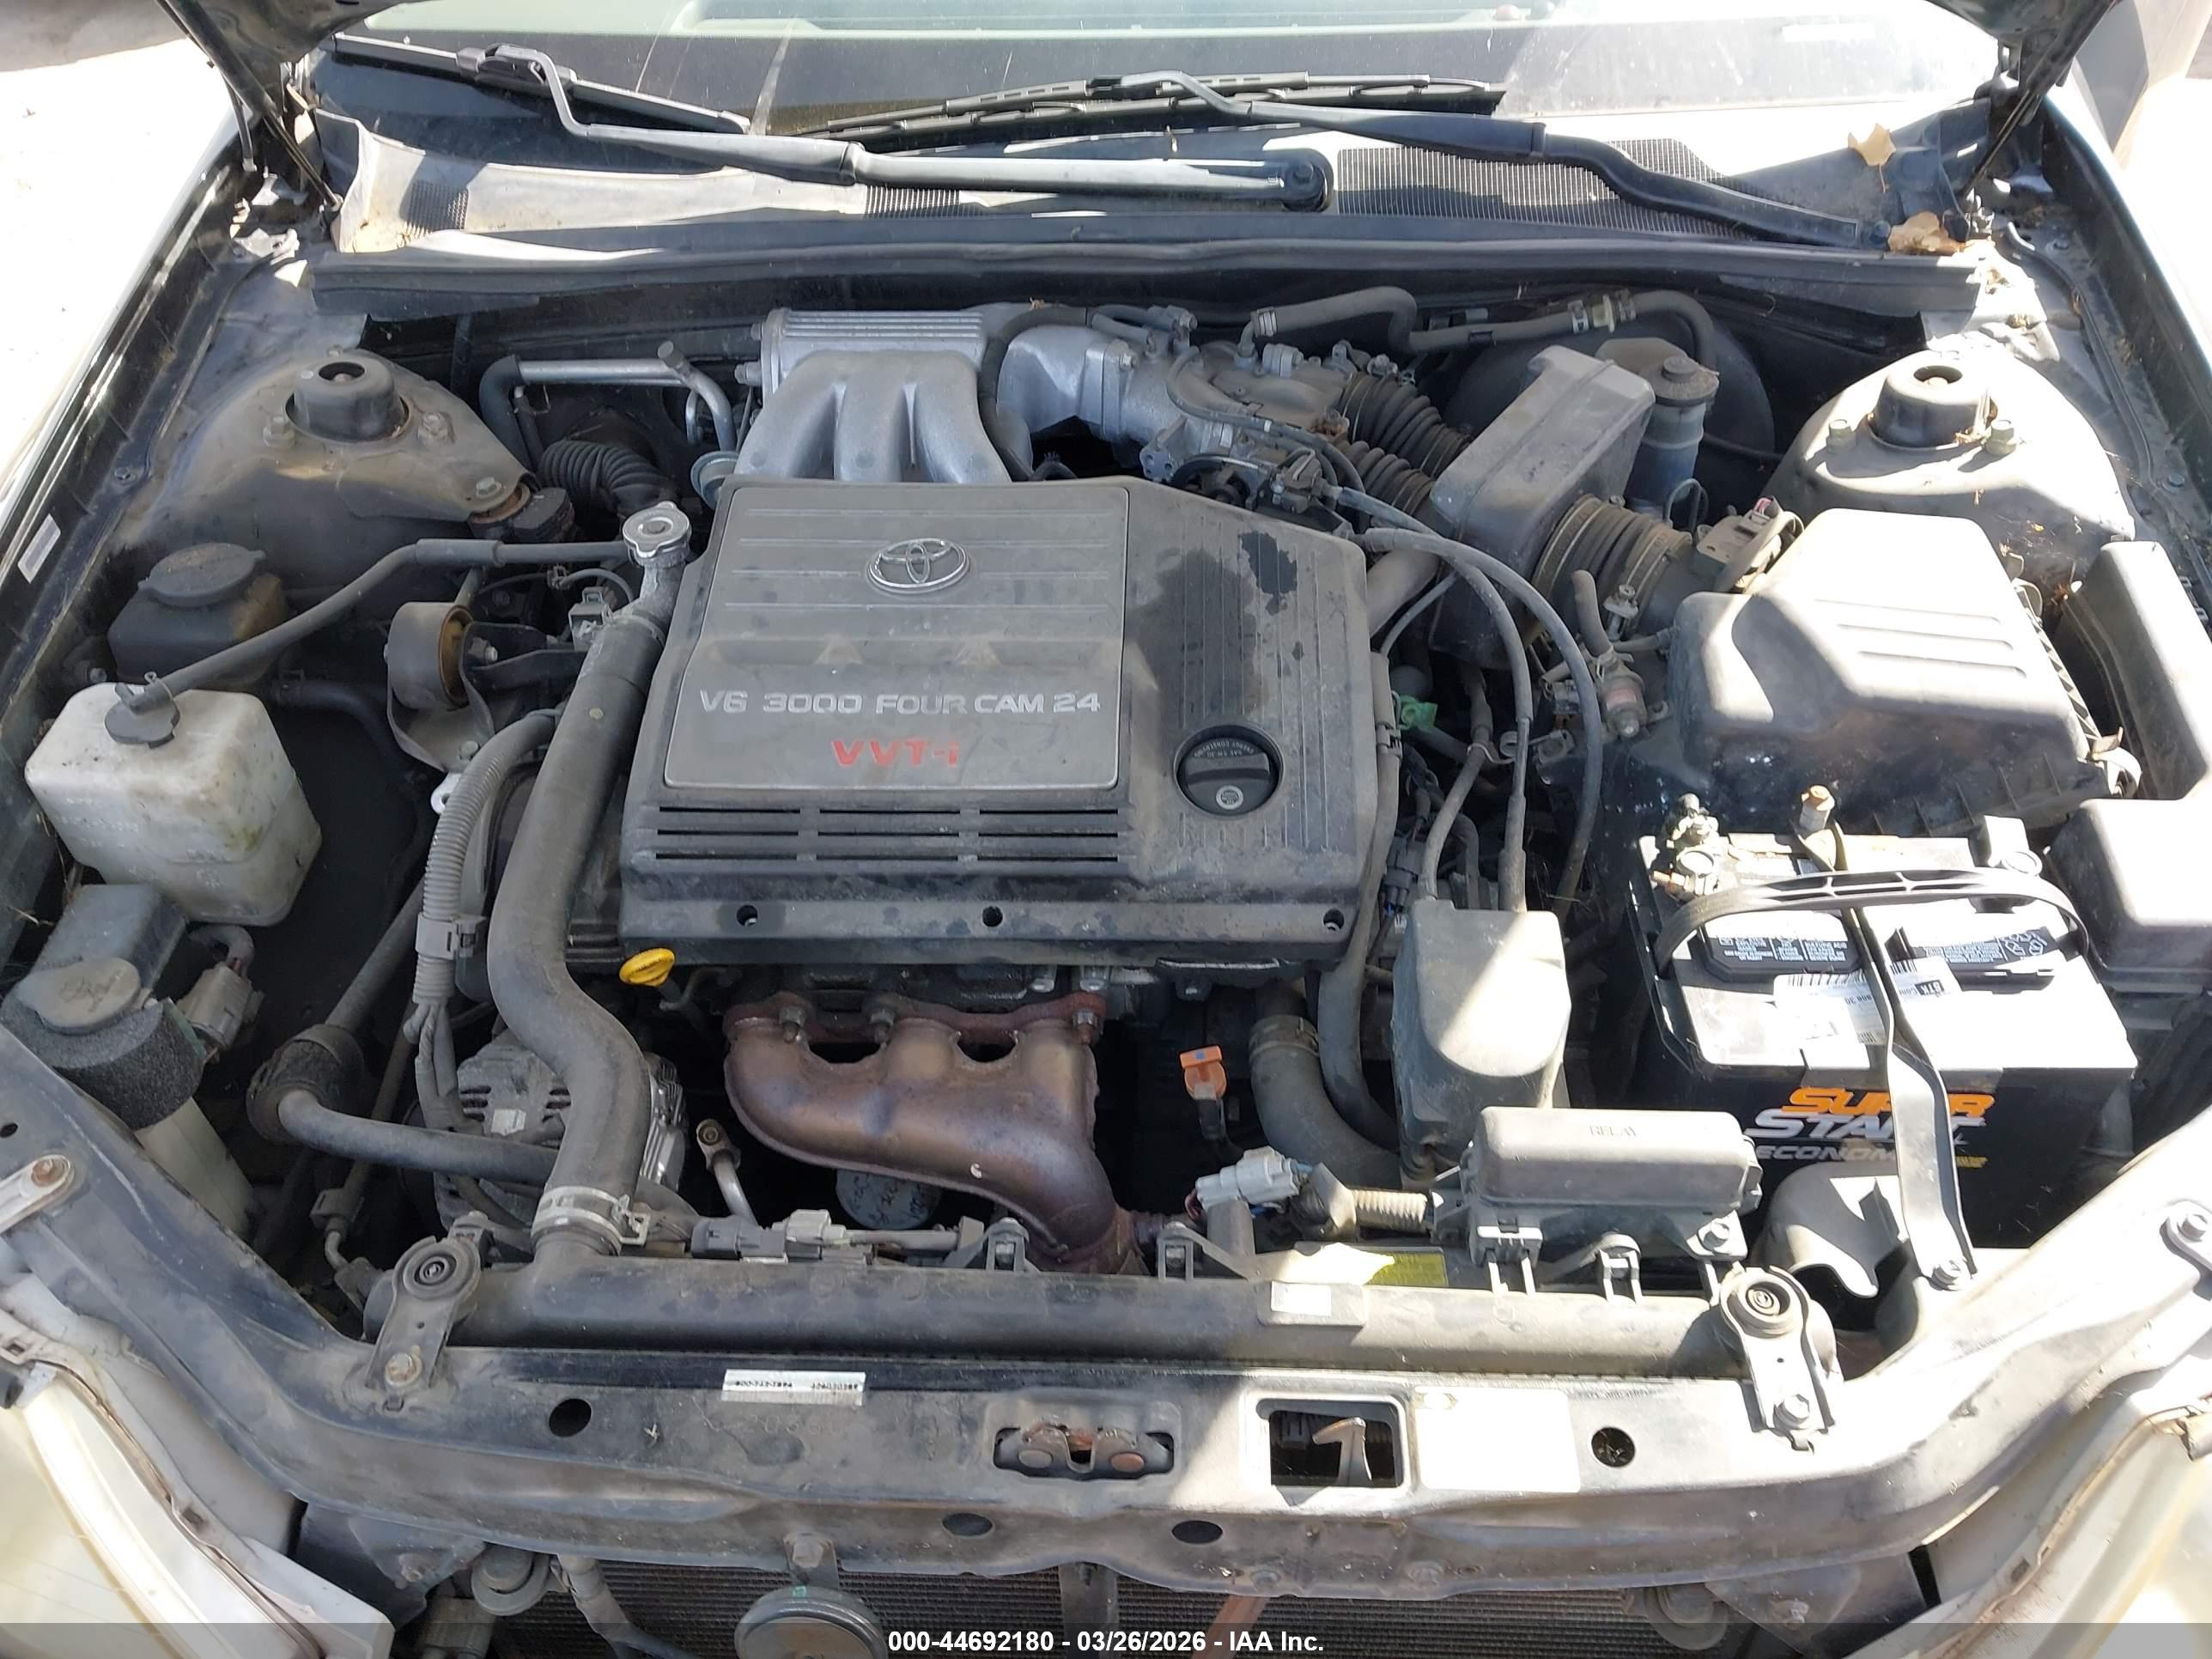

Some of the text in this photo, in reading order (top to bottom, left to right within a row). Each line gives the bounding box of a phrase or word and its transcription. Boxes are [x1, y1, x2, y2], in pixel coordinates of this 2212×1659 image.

[700, 690, 1101, 715] V6 3000 FOUR CAM 24
[832, 739, 960, 767] VVT-i
